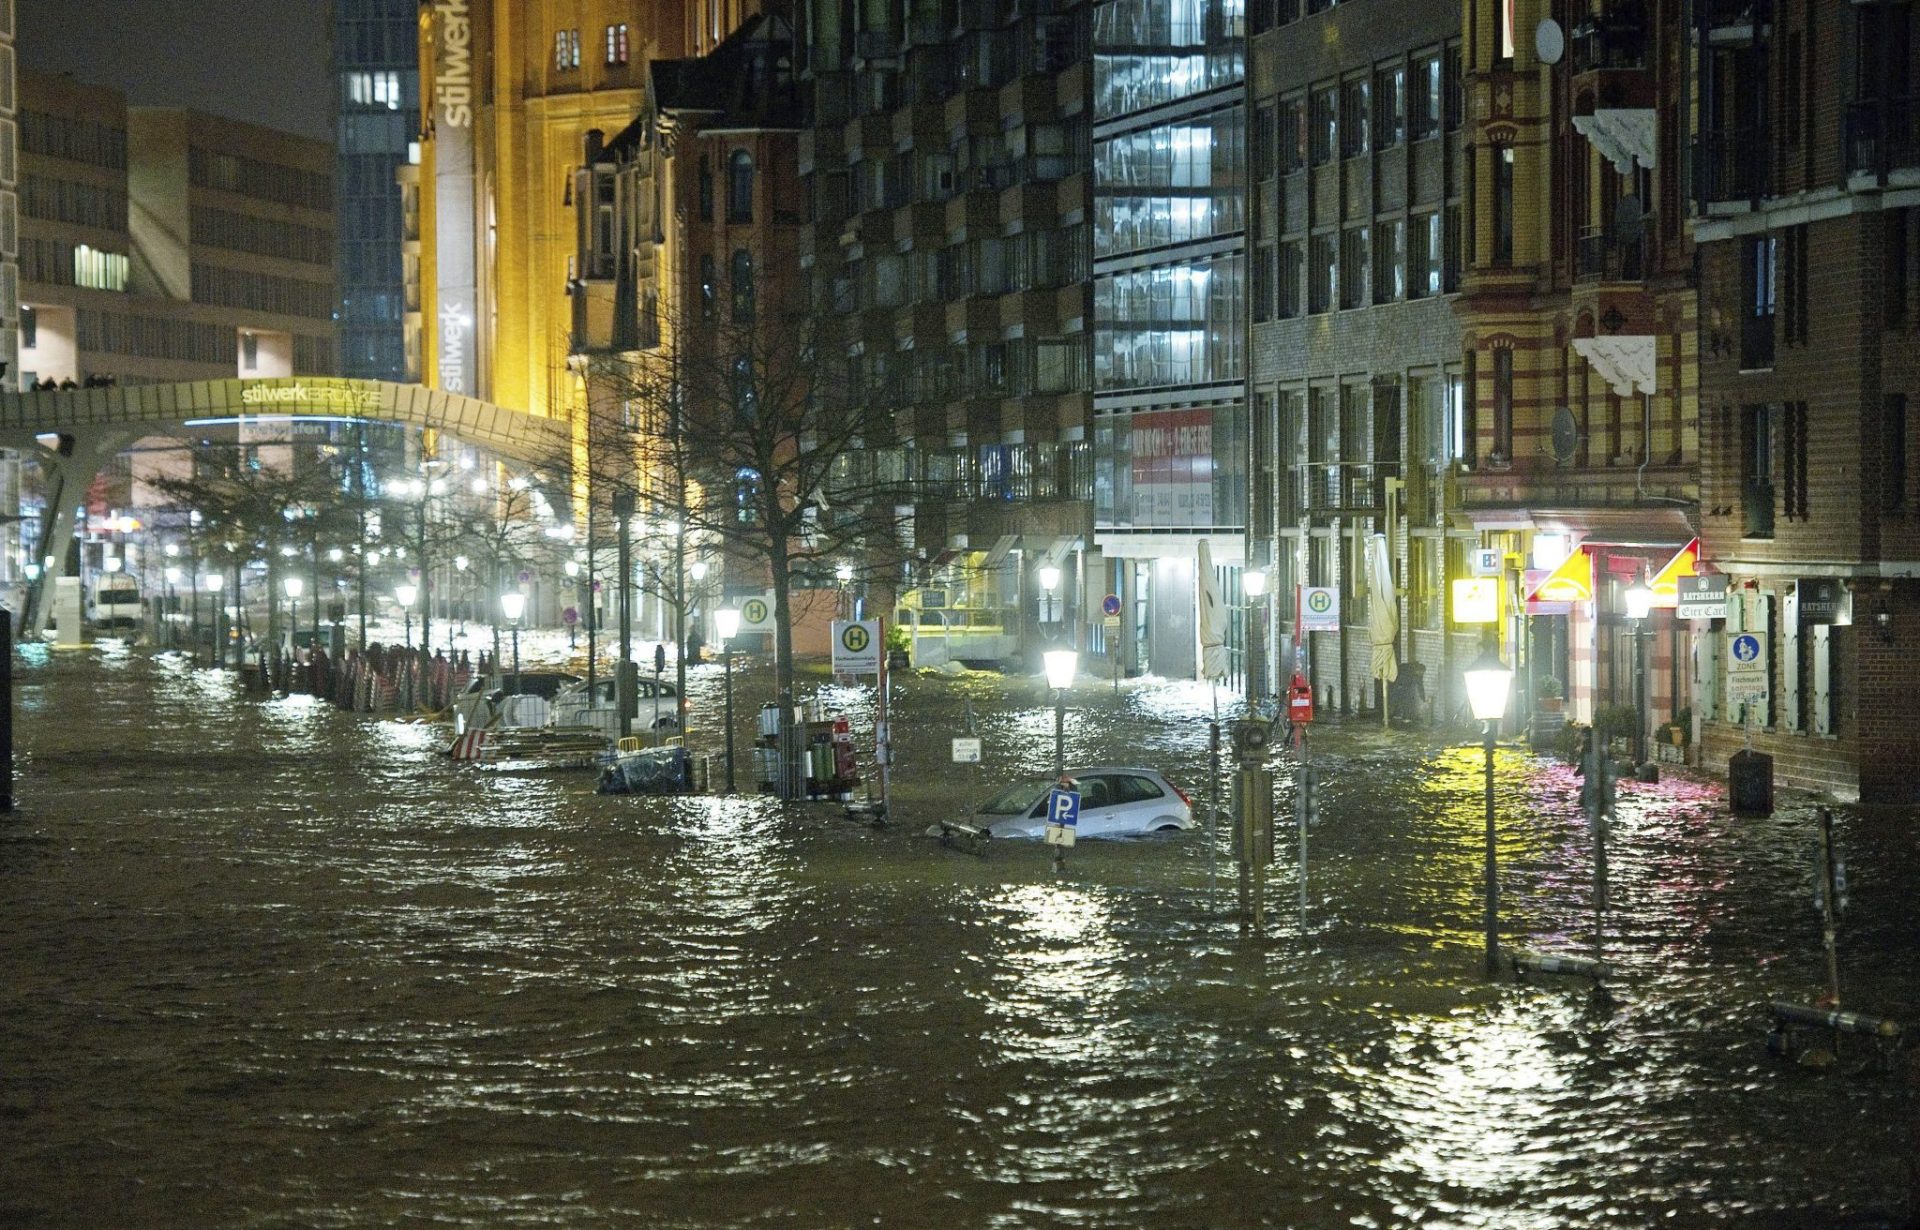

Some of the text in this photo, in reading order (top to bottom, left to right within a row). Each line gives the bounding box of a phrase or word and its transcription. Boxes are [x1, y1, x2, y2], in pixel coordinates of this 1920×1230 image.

[435, 0, 471, 128] stilwerk
[439, 303, 463, 391] stilwerk
[1737, 662, 1757, 671] ZONE
[1055, 794, 1073, 820] P
